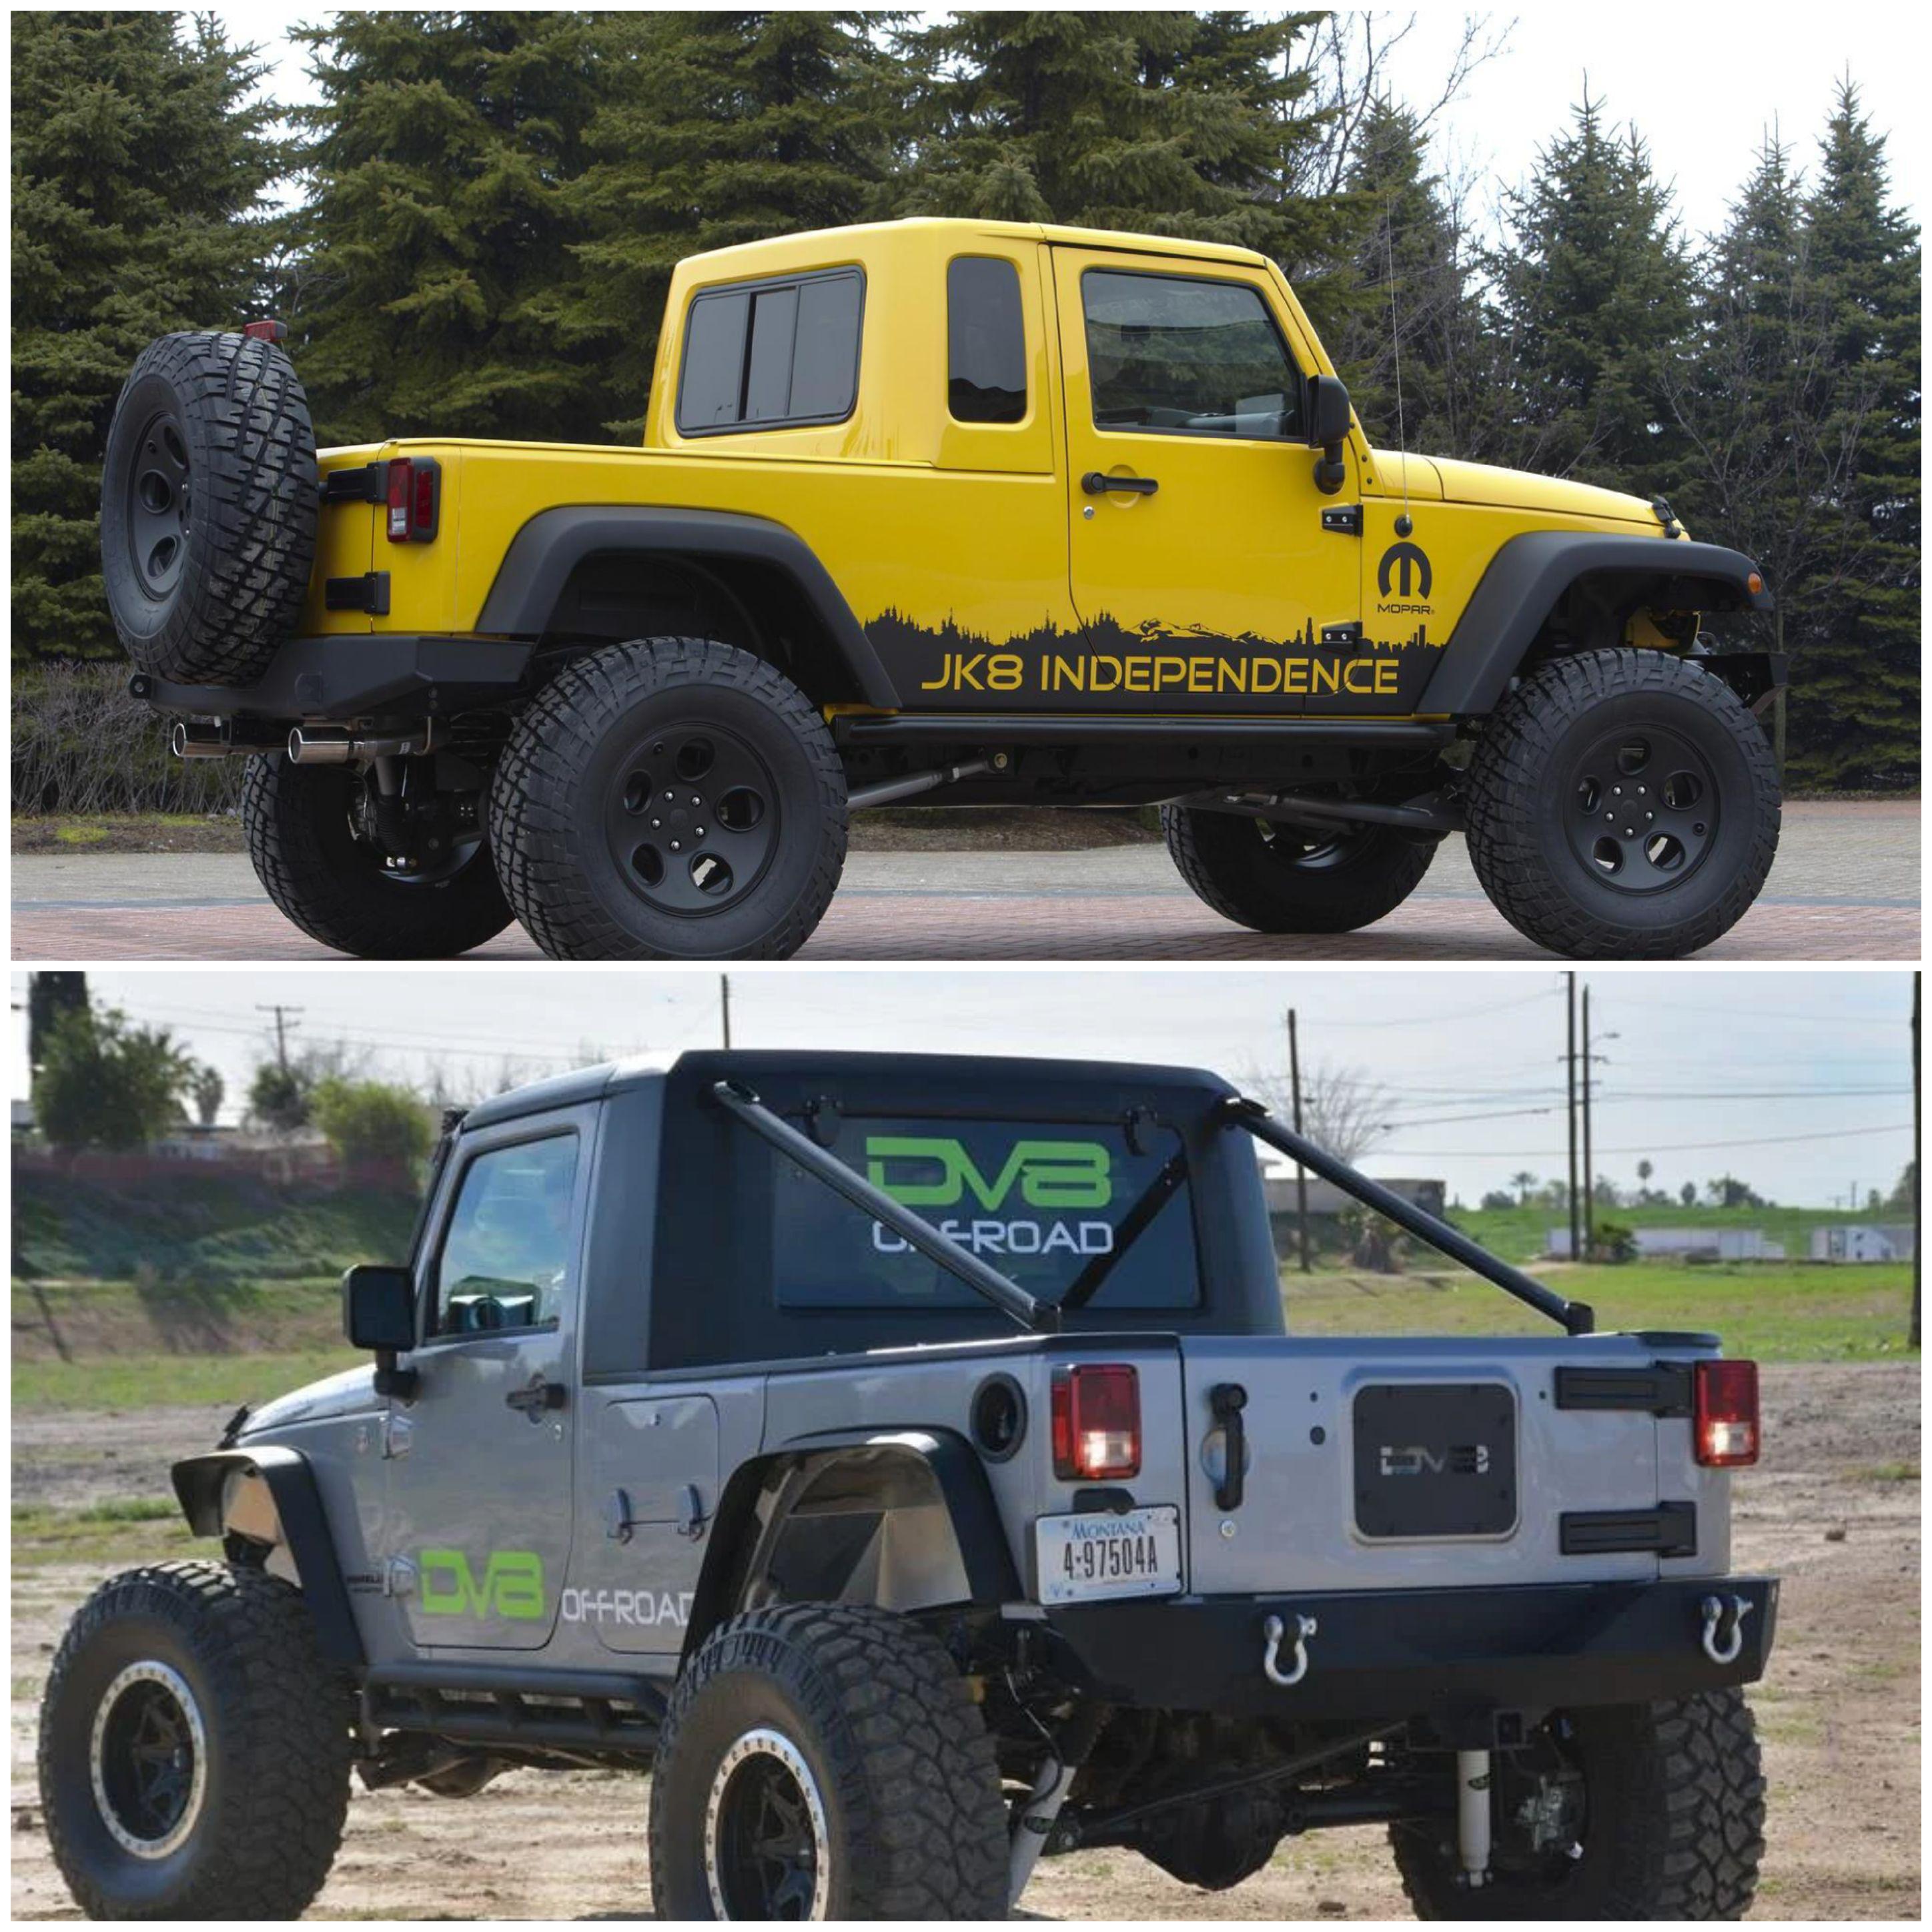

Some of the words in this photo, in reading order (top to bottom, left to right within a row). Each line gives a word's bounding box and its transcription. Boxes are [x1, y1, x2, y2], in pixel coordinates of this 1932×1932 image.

[1377, 603, 1430, 615] MOPAR
[921, 653, 1024, 691] JK8
[1041, 654, 1400, 694] INDEPENDENCE
[867, 1136, 1111, 1212] DV8
[1072, 1520, 1145, 1540] MONTANA
[420, 1549, 546, 1619] DV8
